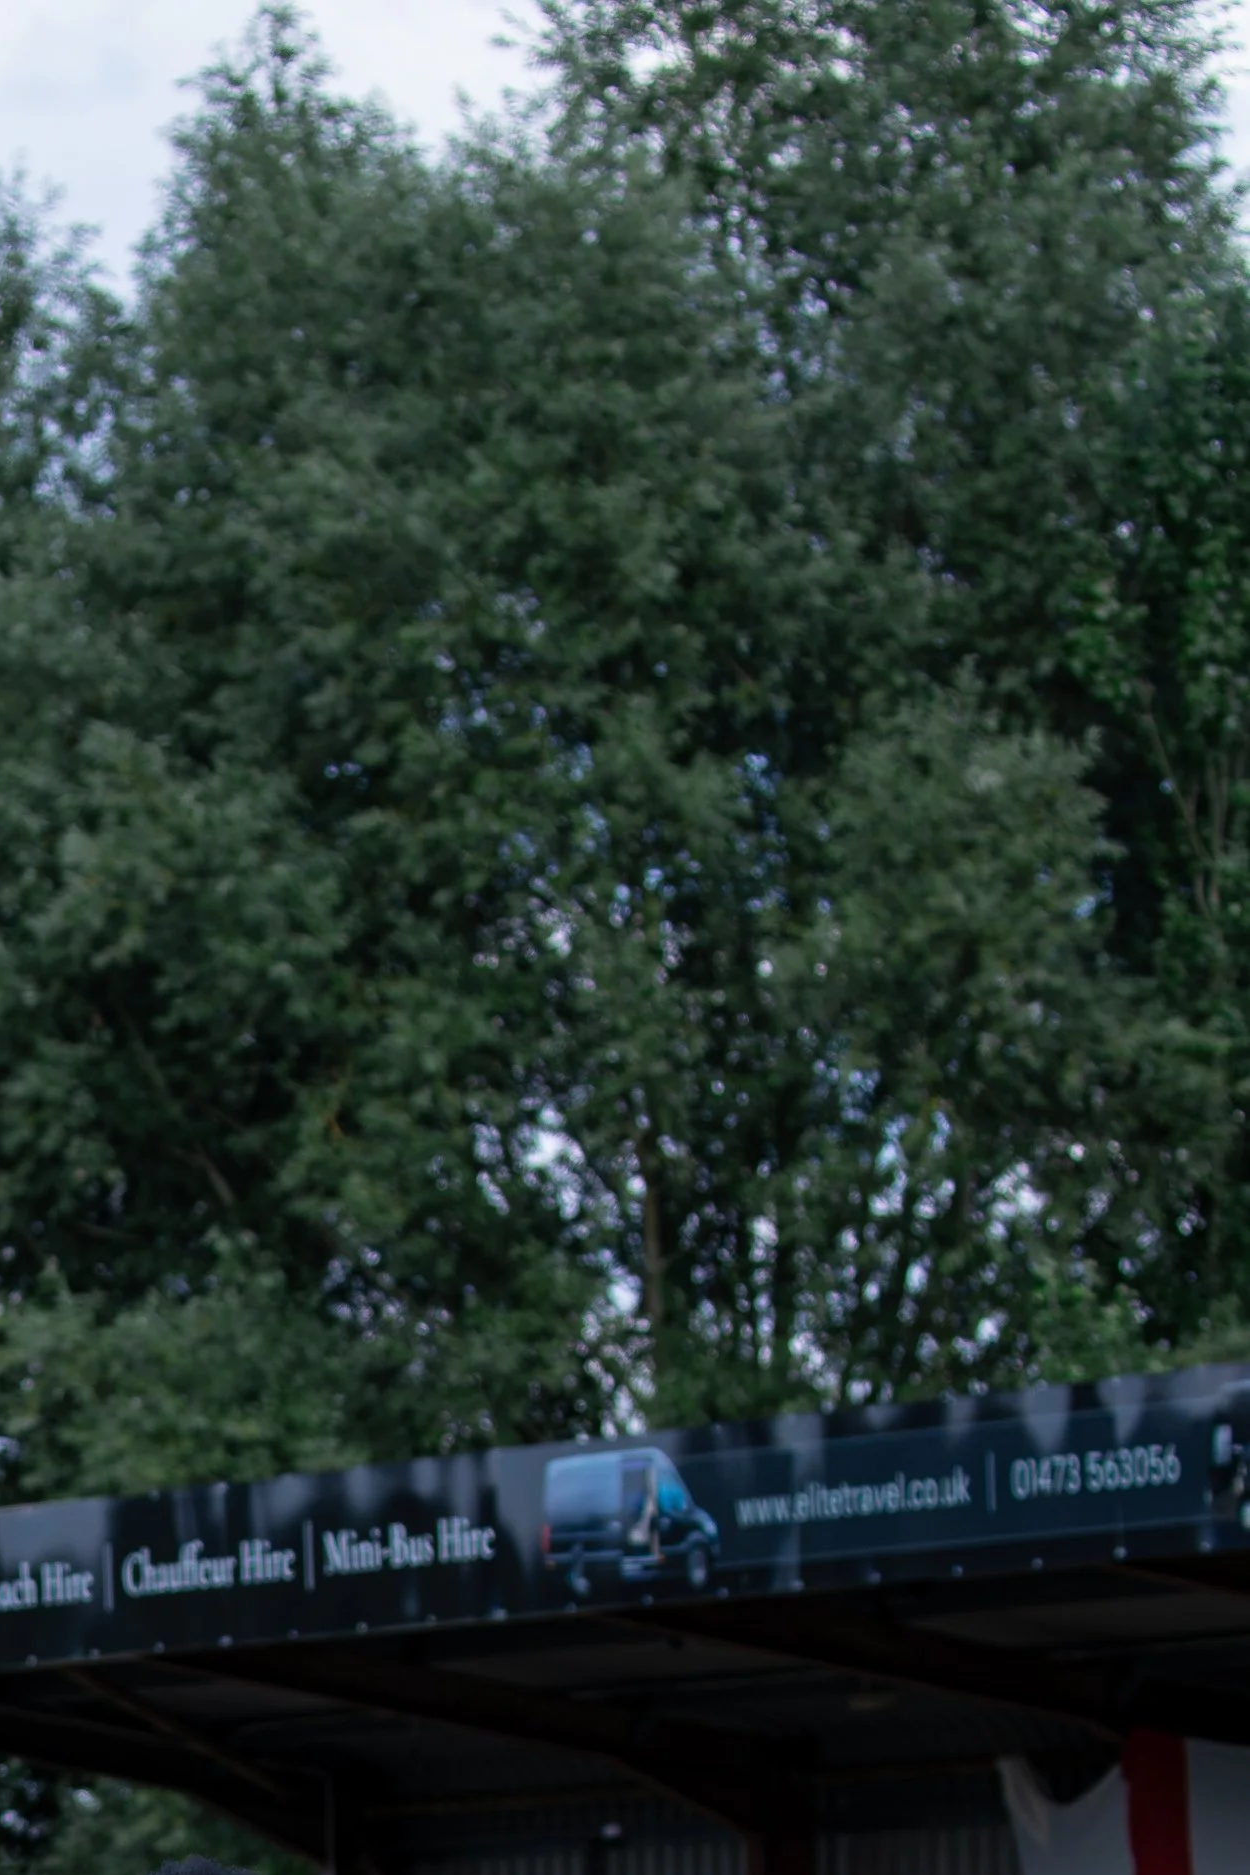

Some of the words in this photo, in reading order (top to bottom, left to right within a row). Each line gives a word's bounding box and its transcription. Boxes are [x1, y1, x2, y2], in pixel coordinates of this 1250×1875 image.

[735, 1465, 971, 1527] www.elitetravel.co.uk
[1010, 1453, 1081, 1501] 01473
[1085, 1443, 1181, 1491] 563056
[39, 1560, 94, 1604] Hire
[122, 1539, 237, 1598] Chauffeur
[240, 1538, 296, 1583] Hire
[322, 1521, 434, 1576] Mini-Bus
[438, 1515, 495, 1563] Hire
